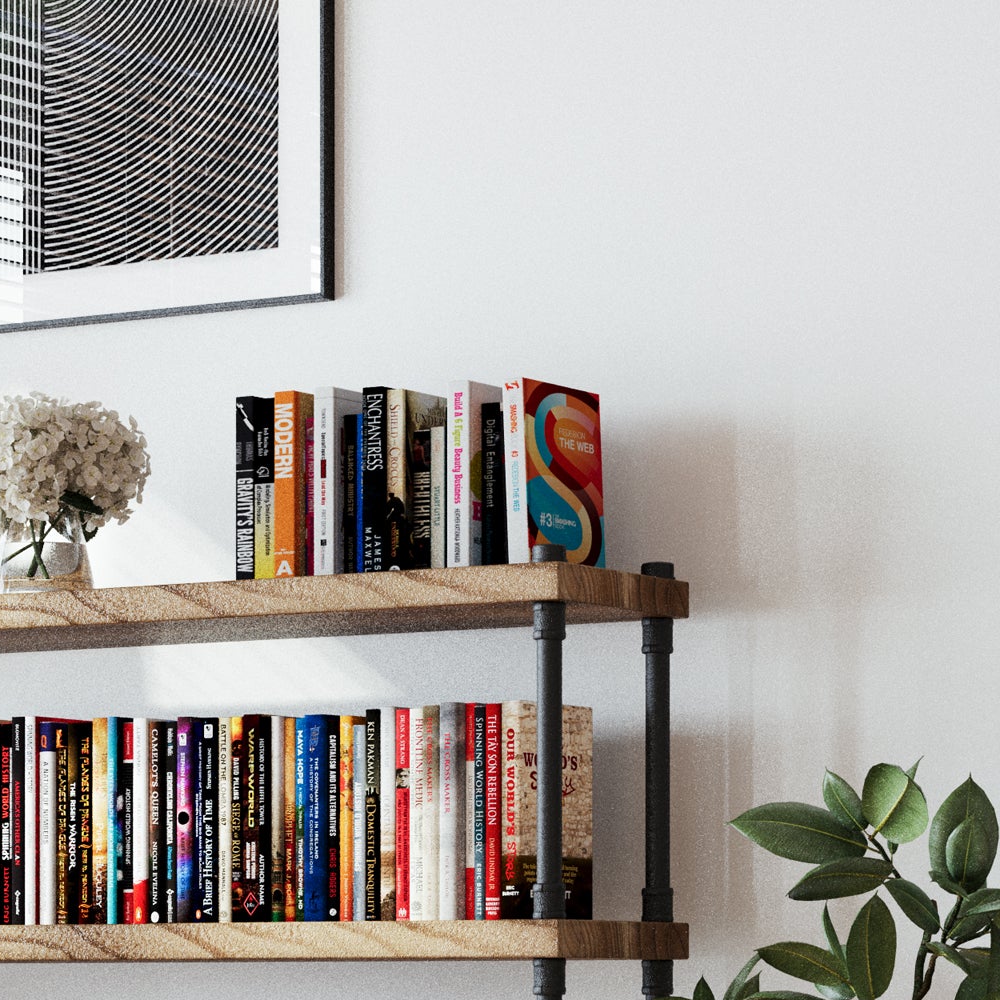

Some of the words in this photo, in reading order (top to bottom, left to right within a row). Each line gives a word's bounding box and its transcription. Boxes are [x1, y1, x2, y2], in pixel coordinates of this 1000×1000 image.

[454, 392, 463, 410] Build
[367, 394, 383, 470] ENCHANTRESS
[390, 404, 401, 438] SHIELD
[452, 425, 461, 446] Figure
[485, 419, 495, 446] Digital
[274, 404, 294, 479] MODERN
[560, 438, 575, 450] THE
[577, 443, 594, 454] WEB
[388, 447, 401, 487] CROCUS
[452, 449, 462, 473] Beauty
[454, 474, 463, 504] Business
[485, 452, 495, 507] Entanglement
[237, 478, 254, 527] GRAVITY'S
[540, 513, 552, 527] #3
[237, 528, 253, 573] RAINBOW
[367, 721, 375, 741] KEN
[488, 715, 496, 734] THE
[329, 735, 337, 769] CAPITALISM
[475, 717, 483, 767] SPINNING
[506, 728, 515, 761] OUR
[221, 754, 226, 764] ON
[232, 758, 240, 775] DAVID
[259, 764, 265, 772] OF
[367, 744, 375, 784] PAKMAN
[232, 777, 240, 800] PILLING
[247, 728, 255, 828] WARPWORLD
[329, 771, 337, 782] AND
[329, 784, 337, 793] ITS
[475, 771, 483, 808] WORLD
[203, 800, 213, 822] TIME
[329, 795, 337, 836] ALTERNATIVES
[488, 776, 496, 825] REBELLION
[506, 767, 515, 836] WORLD'S
[203, 823, 213, 835] OF
[366, 804, 376, 856] DOMESTIC
[475, 811, 483, 853] HISTORY
[68, 824, 77, 871] WARRIOR
[203, 839, 213, 877] HISTORY
[203, 878, 213, 905] BRIEF
[366, 858, 376, 913] TRANQUILITY
[203, 906, 213, 915] A
